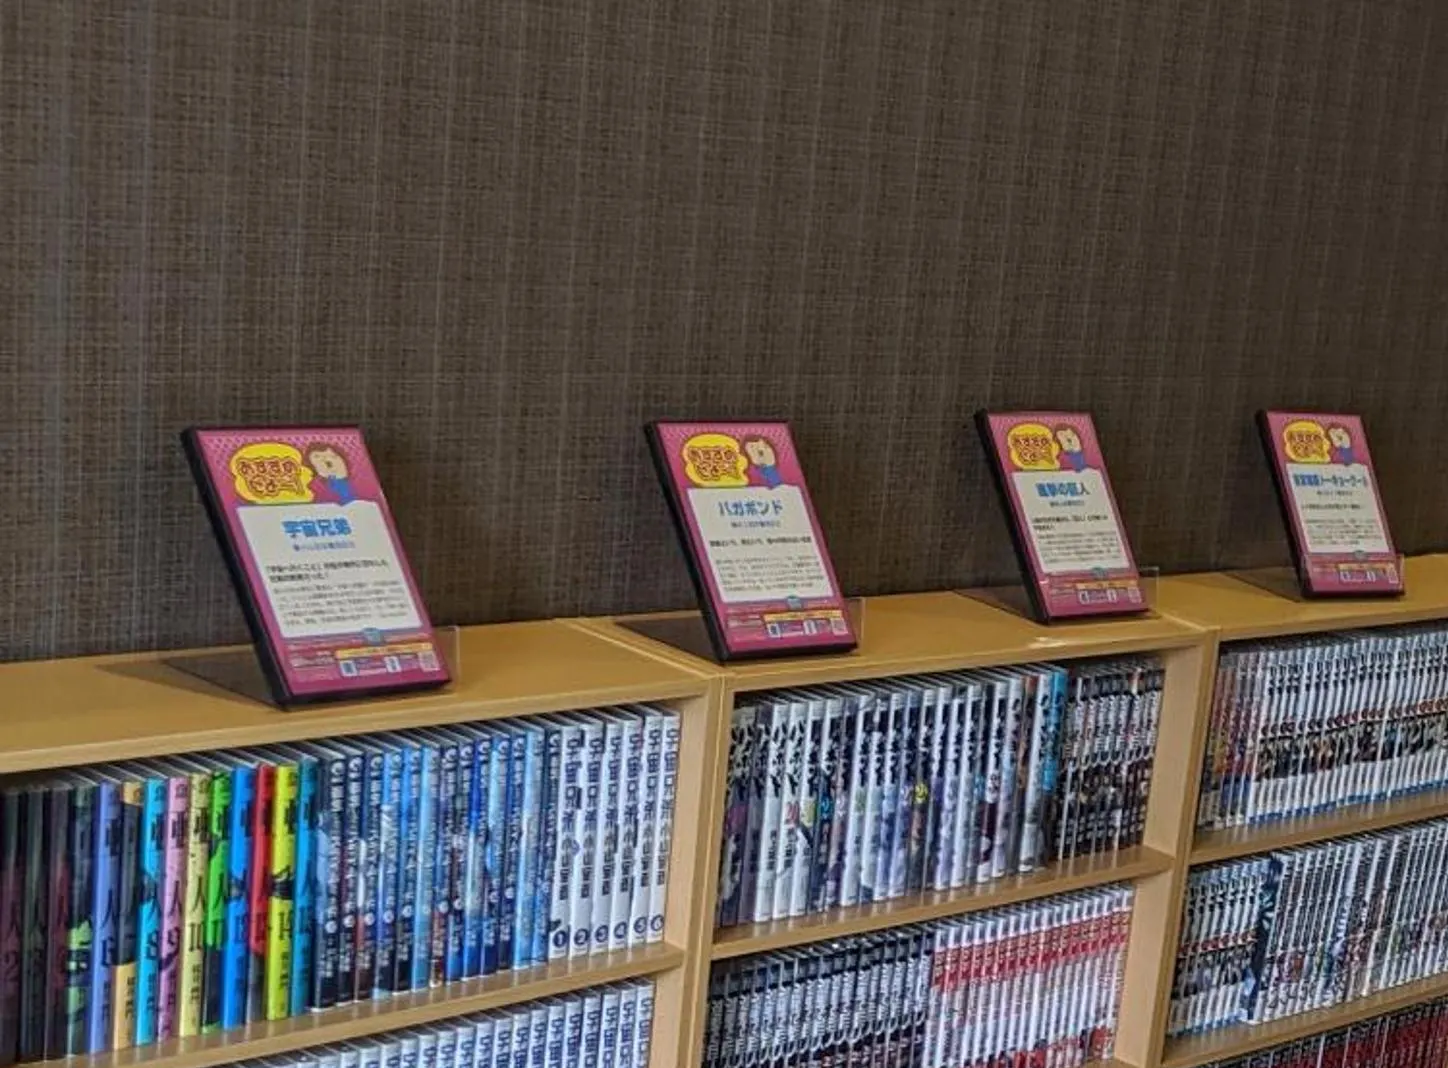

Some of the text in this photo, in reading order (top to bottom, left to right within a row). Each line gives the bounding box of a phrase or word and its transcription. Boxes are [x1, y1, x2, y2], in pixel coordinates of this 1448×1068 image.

[718, 499, 784, 517] バガボンド
[282, 517, 352, 538] 宇宙兄弟
